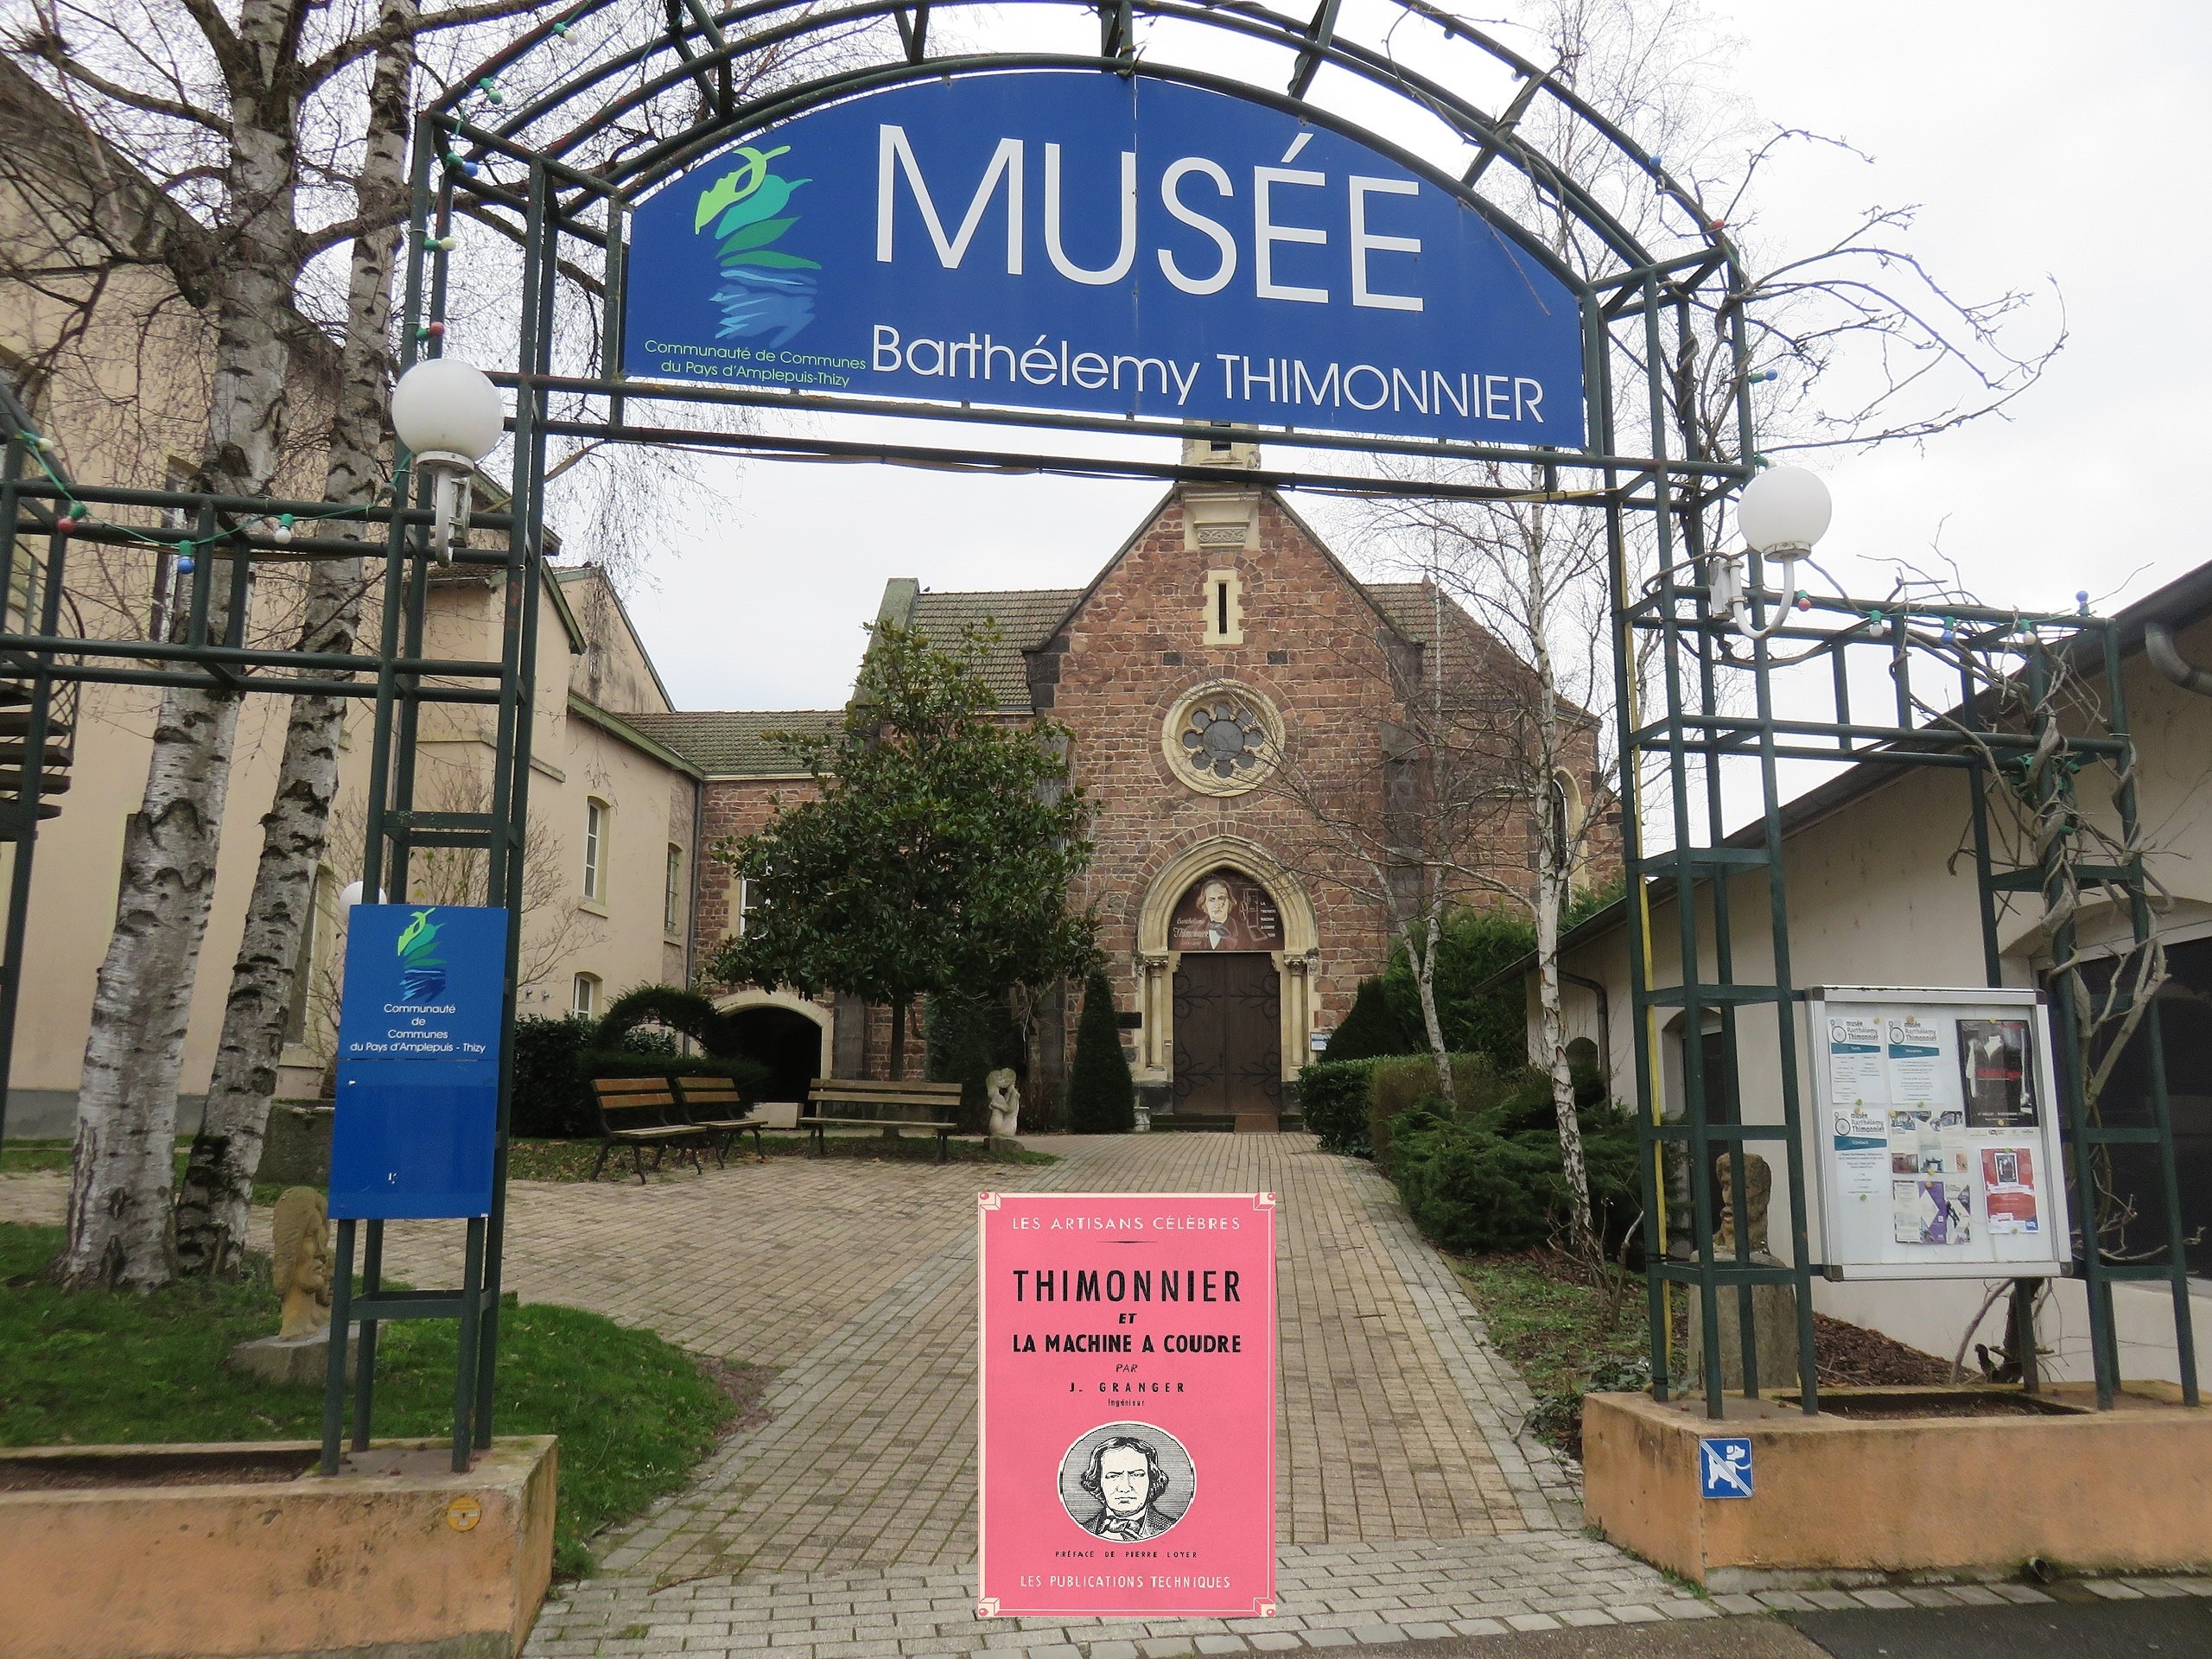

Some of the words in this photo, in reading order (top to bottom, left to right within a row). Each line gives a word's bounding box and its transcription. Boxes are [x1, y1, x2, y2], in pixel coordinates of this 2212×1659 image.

[876, 124, 1425, 313] MUSÉE
[645, 340, 752, 360] Communauté
[755, 349, 776, 362] de
[779, 351, 867, 370] Communes
[661, 359, 681, 372] du
[685, 361, 718, 377] Pays
[722, 364, 850, 389] d'Amplepuis-Thizy
[873, 324, 1201, 406] Barthélemy
[1216, 353, 1545, 423] THIMONNIER
[384, 1003, 456, 1014] Communauté
[411, 1017, 426, 1026] de
[388, 1029, 448, 1039] Communes
[350, 1042, 364, 1052] du
[365, 1042, 387, 1052] Pays
[391, 1042, 454, 1052] d'Amplepuis
[463, 1043, 486, 1054] Thizy
